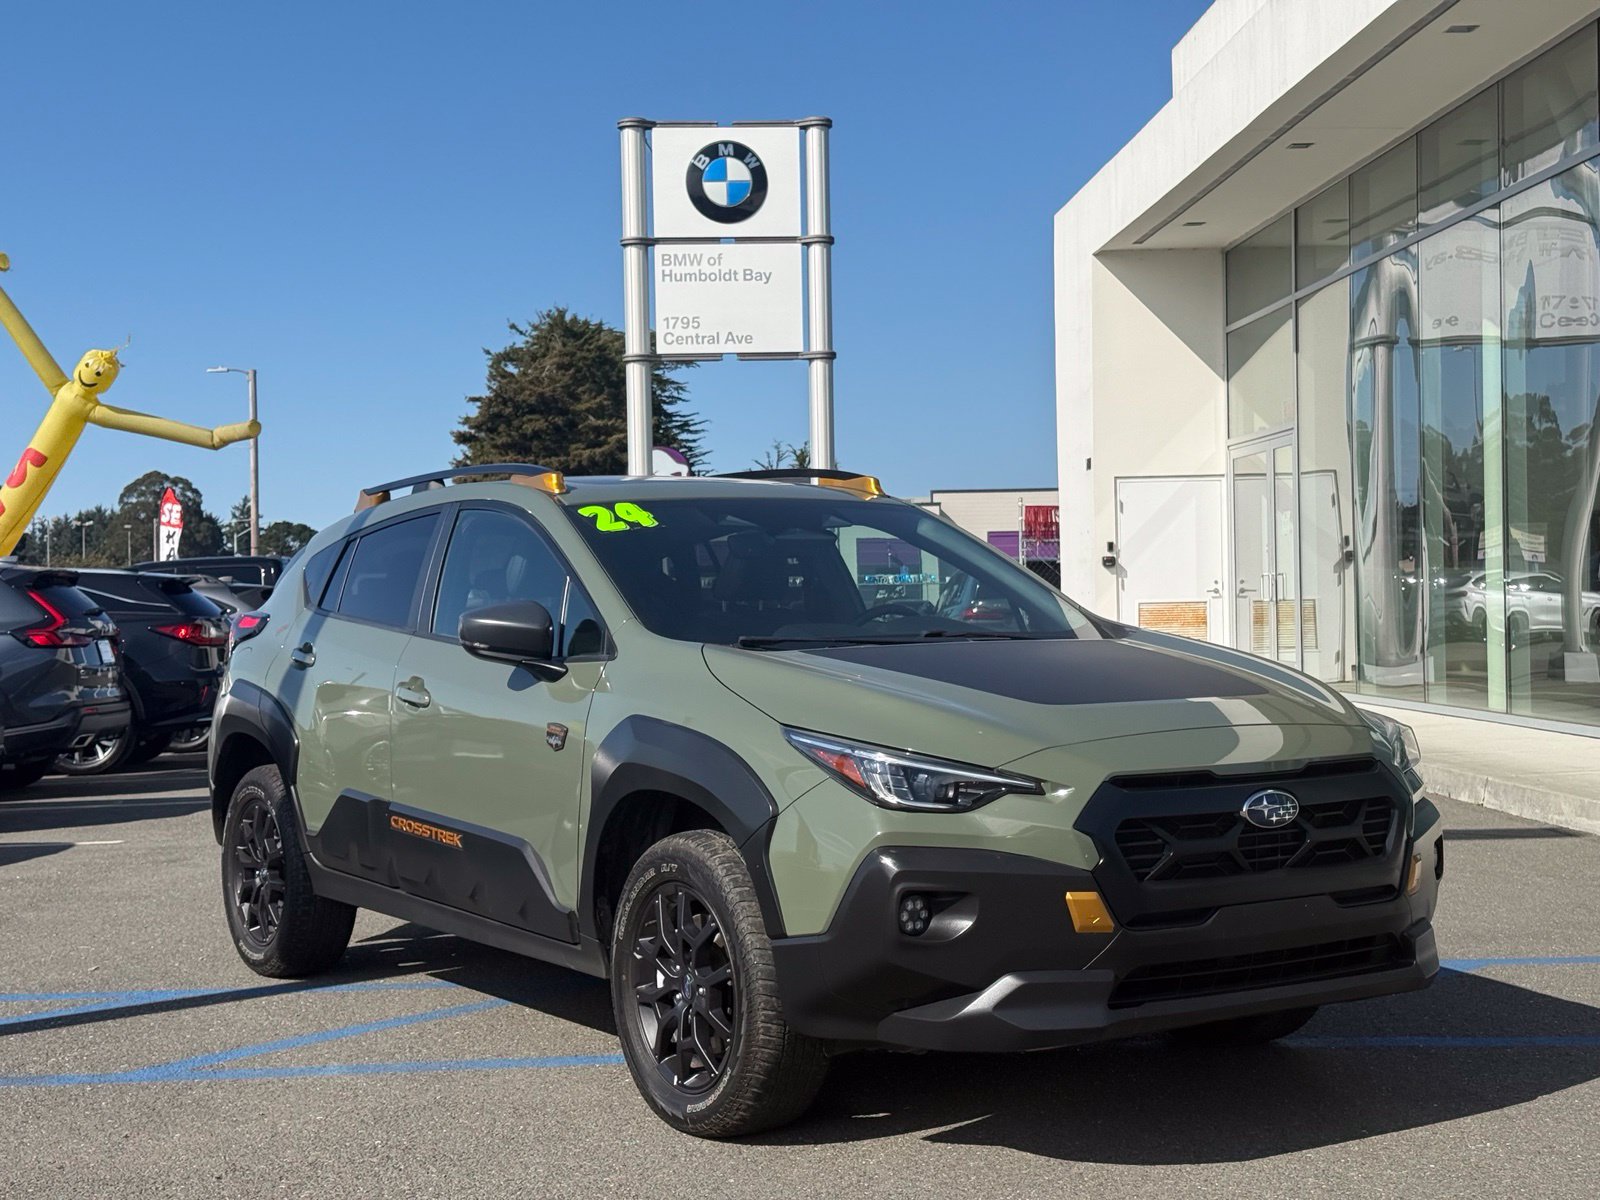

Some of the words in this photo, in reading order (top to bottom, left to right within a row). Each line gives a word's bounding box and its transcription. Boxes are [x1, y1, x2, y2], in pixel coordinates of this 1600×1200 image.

[691, 143, 760, 170] BMW
[661, 253, 704, 267] BMW
[707, 253, 723, 267] of
[661, 269, 739, 283] Humboldt
[743, 269, 772, 285] Bay
[663, 316, 701, 330] 1795
[663, 332, 720, 346] Central
[724, 331, 753, 345] Ave
[577, 502, 659, 532] 24
[390, 815, 464, 849] CROSSTREK
